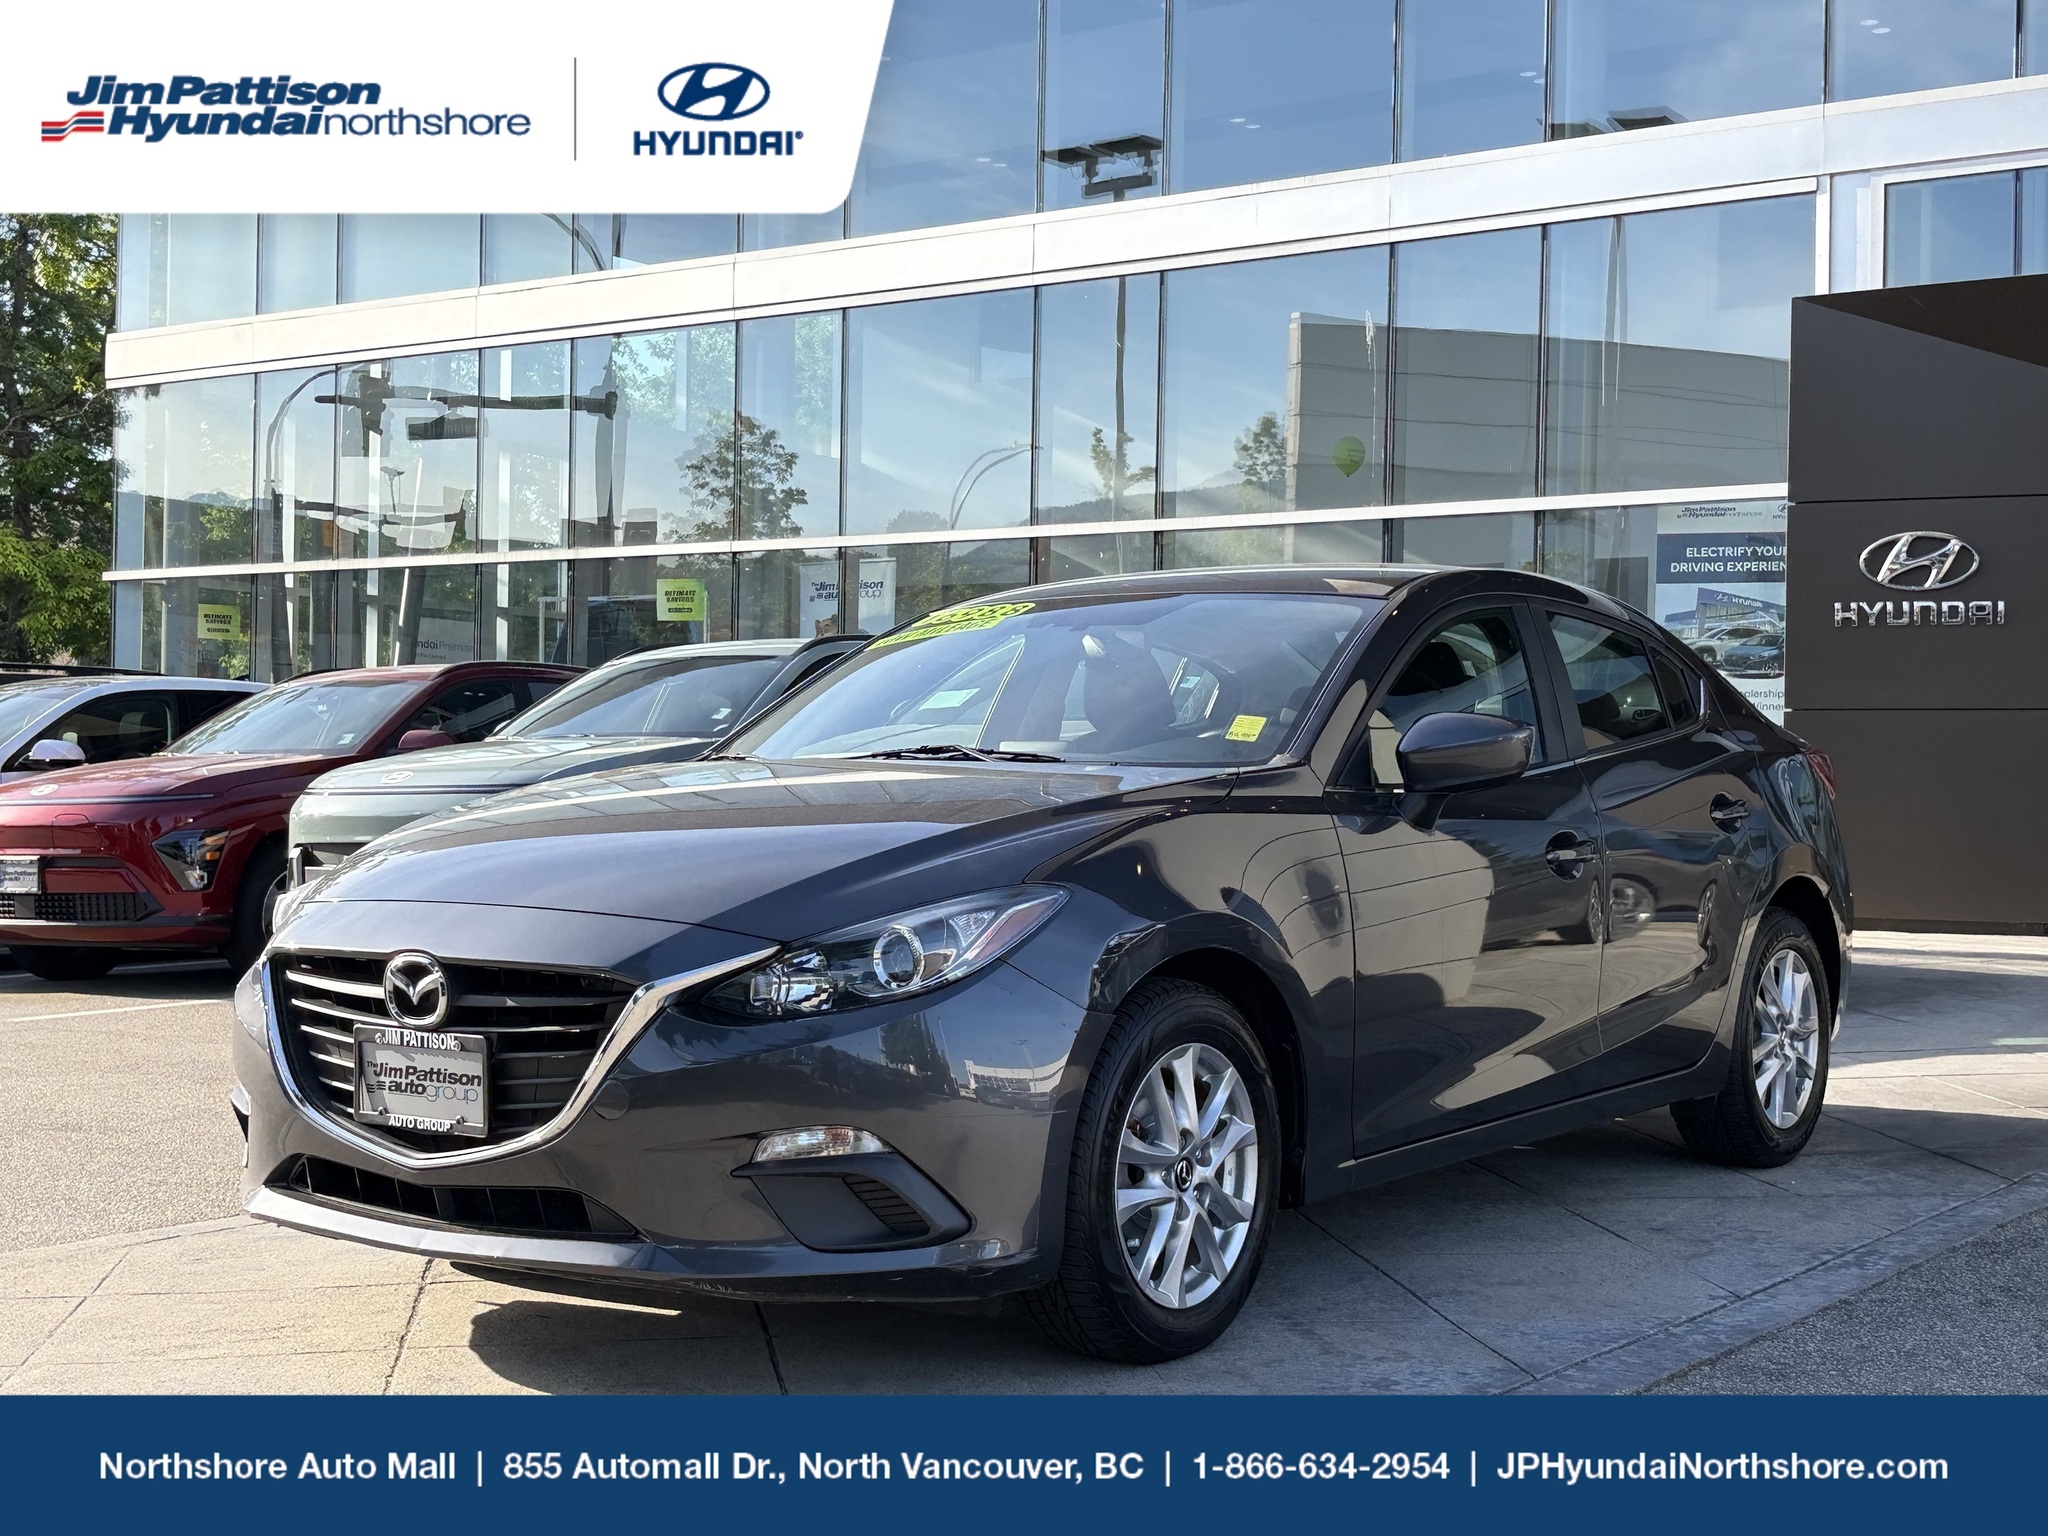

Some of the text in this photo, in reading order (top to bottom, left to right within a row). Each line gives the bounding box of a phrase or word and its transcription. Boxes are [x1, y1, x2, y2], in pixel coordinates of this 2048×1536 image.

[1685, 546, 1754, 558] ELECTRIFY
[1670, 560, 1787, 573] DRIVING EXPERIEN
[1833, 600, 2006, 628] HYUNDAI
[1739, 689, 1784, 700] alership
[383, 1029, 455, 1051] JIM PATTISON
[373, 1062, 404, 1079] Jim
[404, 1065, 483, 1087] Pattison
[388, 1115, 451, 1132] AUTO GROUP
